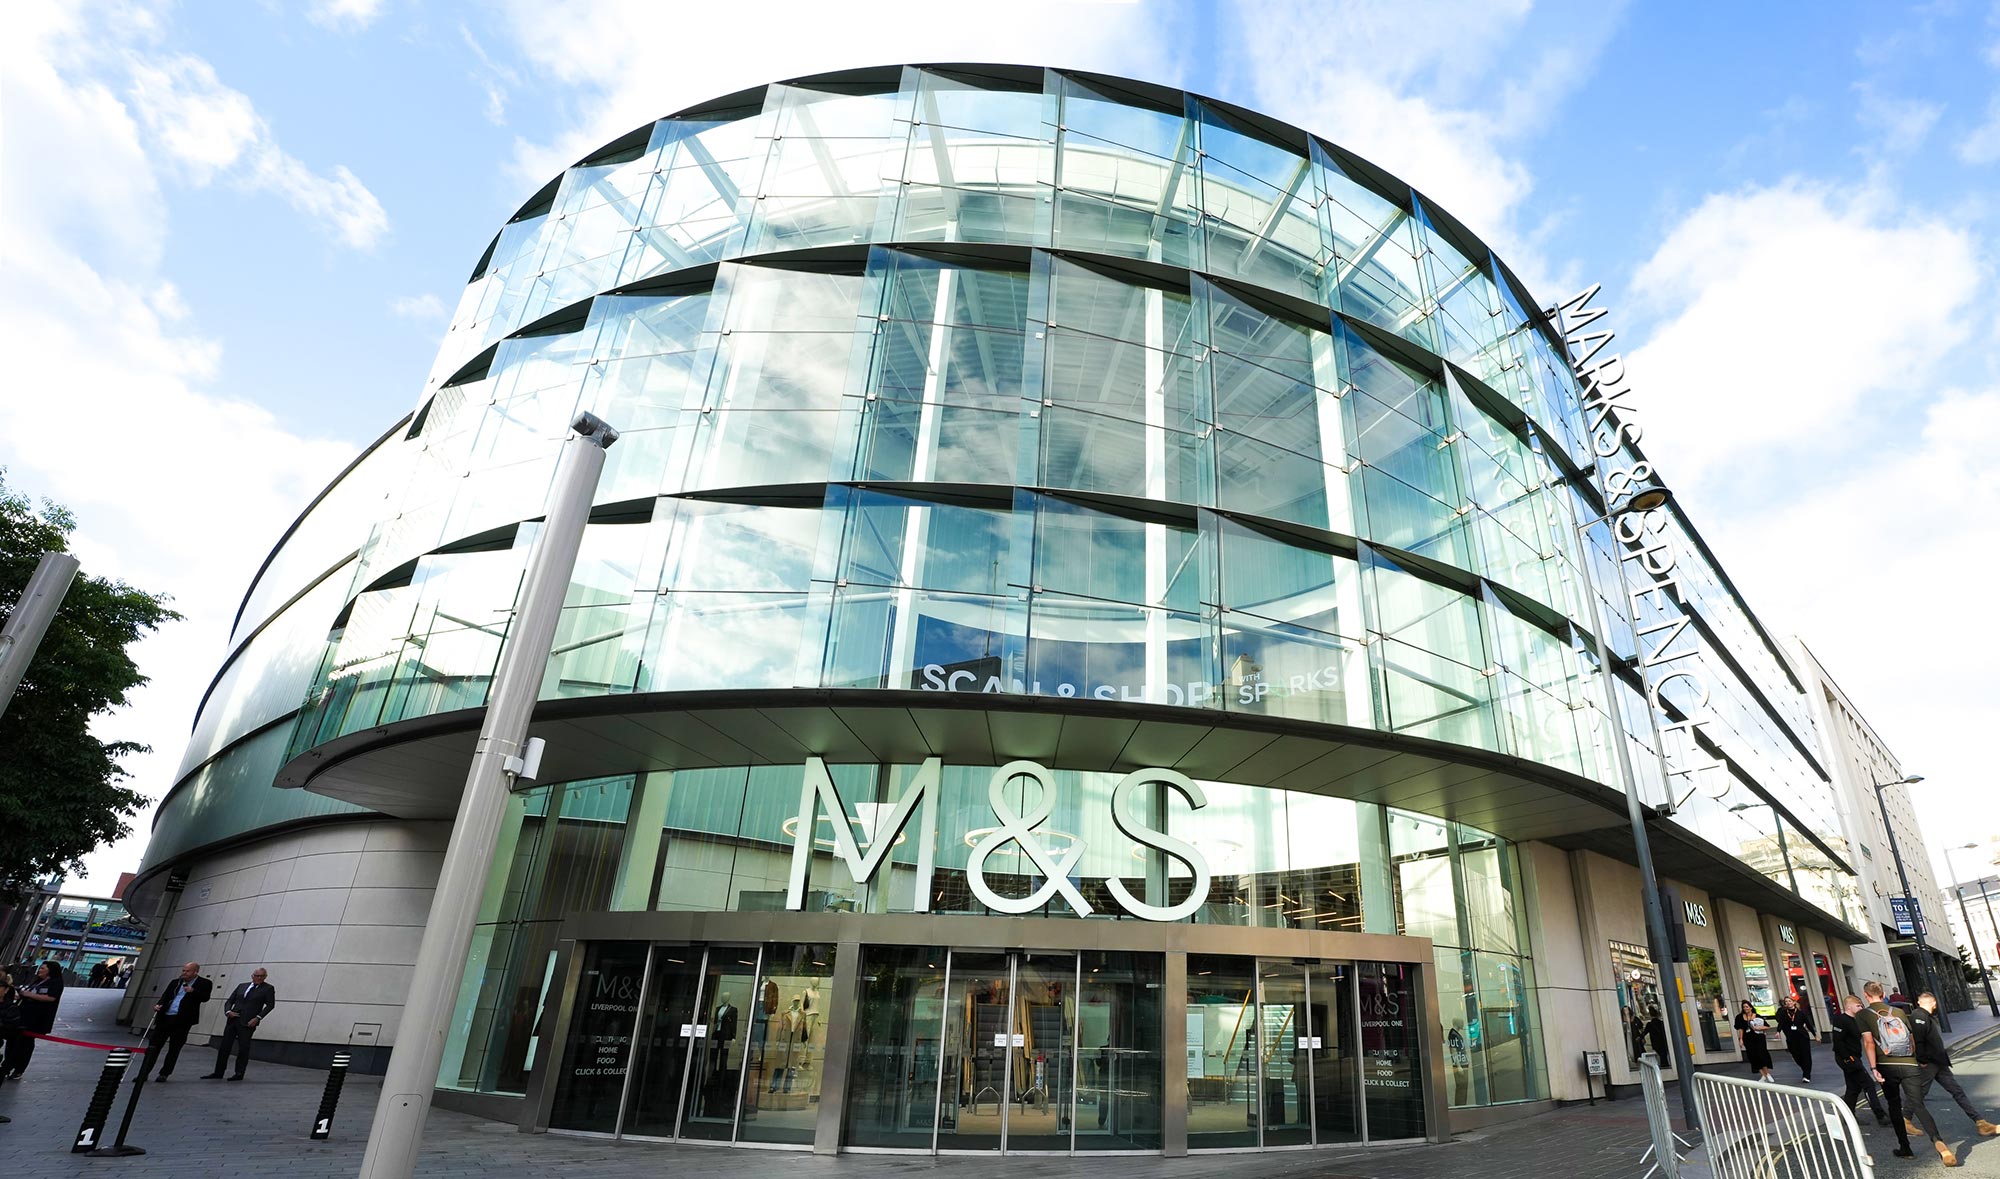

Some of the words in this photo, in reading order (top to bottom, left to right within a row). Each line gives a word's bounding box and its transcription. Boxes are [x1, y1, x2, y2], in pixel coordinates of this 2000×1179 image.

[1557, 282, 1643, 458] MARKS
[1604, 461, 1653, 505] &
[1614, 508, 1732, 809] SPENCER
[786, 756, 1211, 922] M&S
[1683, 900, 1707, 927] M&S
[1778, 924, 1795, 945] M&S
[591, 1003, 627, 1012] LIVERPOOL
[628, 1005, 638, 1013] ON
[1361, 993, 1399, 1015] M&S
[1361, 1020, 1390, 1028] LIVERPOOL
[598, 1046, 619, 1054] HOME
[596, 1057, 616, 1065] FOOD
[1376, 1059, 1393, 1067] HOME
[575, 1068, 596, 1076] CLICK
[603, 1067, 629, 1075] COLLEC
[1377, 1069, 1393, 1077] FOOD
[1364, 1079, 1379, 1087] CLICK
[1385, 1079, 1410, 1088] COLLECT
[315, 1118, 329, 1134] 1
[77, 1128, 95, 1146] 1
